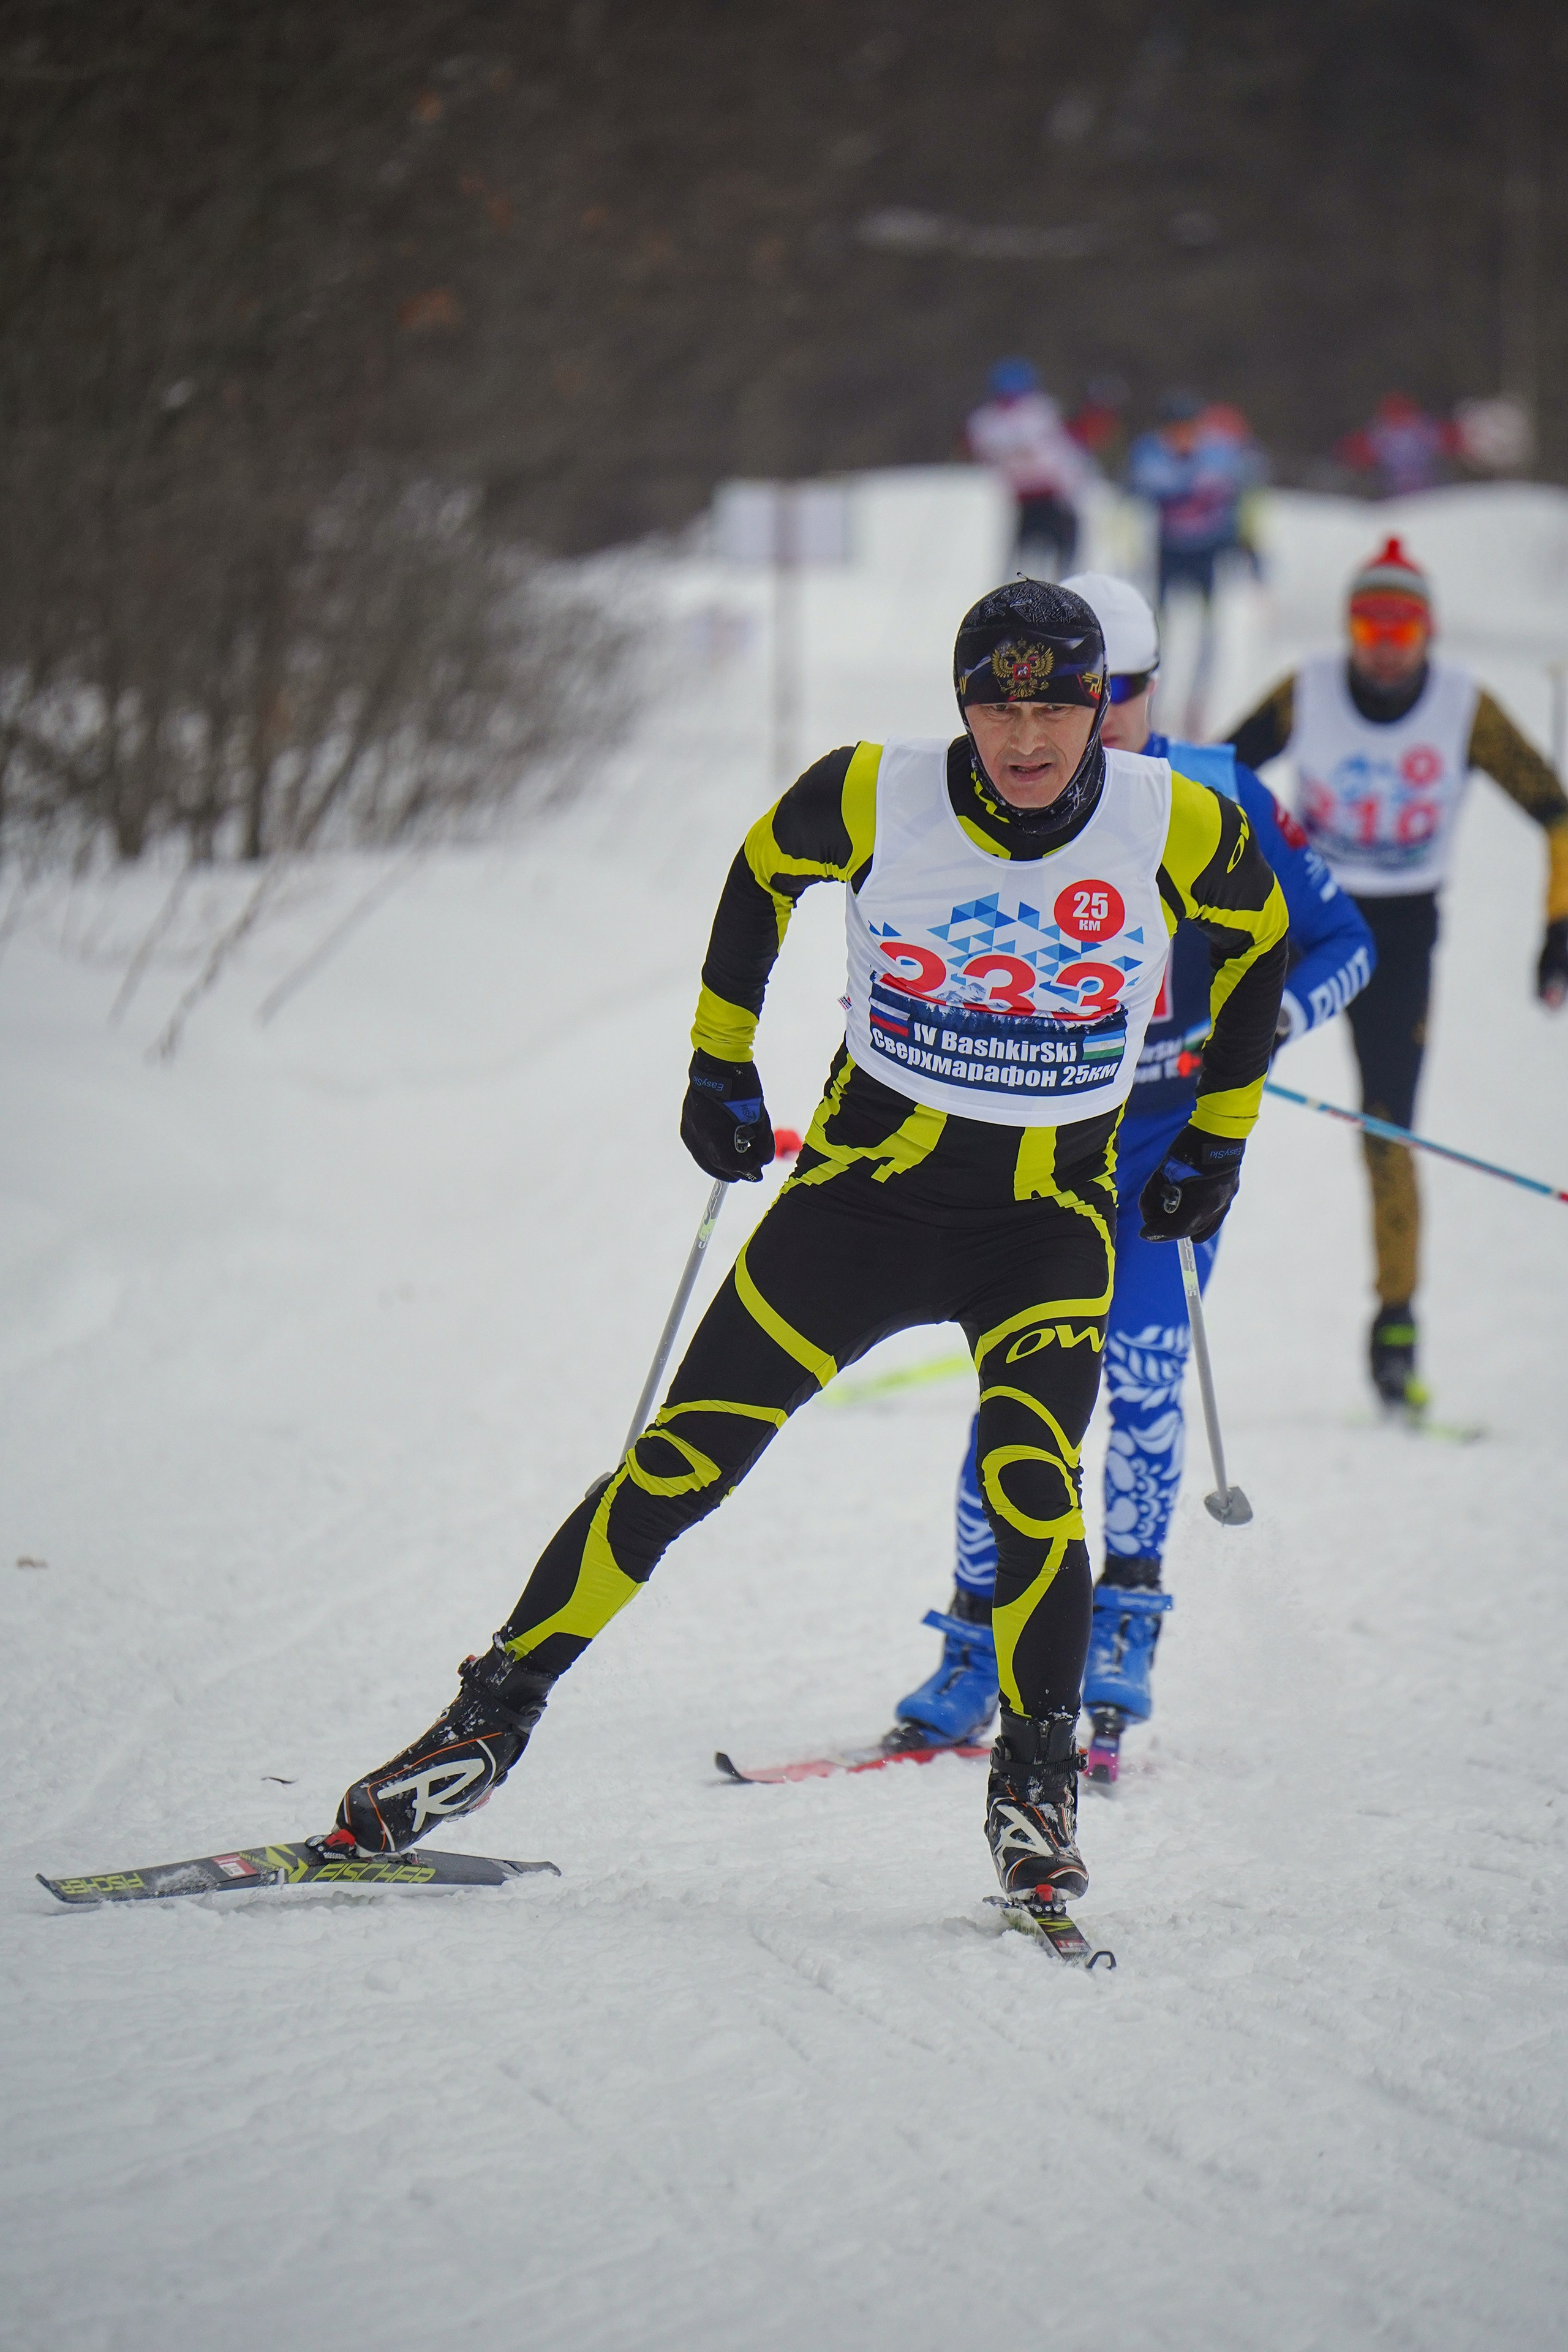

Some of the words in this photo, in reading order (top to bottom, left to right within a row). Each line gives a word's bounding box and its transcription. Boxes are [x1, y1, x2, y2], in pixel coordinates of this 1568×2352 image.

[1072, 891, 1109, 919] 25
[913, 1022, 944, 1047] IV
[941, 1030, 1077, 1063] BashkirSki
[872, 1027, 1057, 1087] Сверхмарафон
[692, 1075, 724, 1091] EasySki
[1209, 1147, 1242, 1159] EasySki
